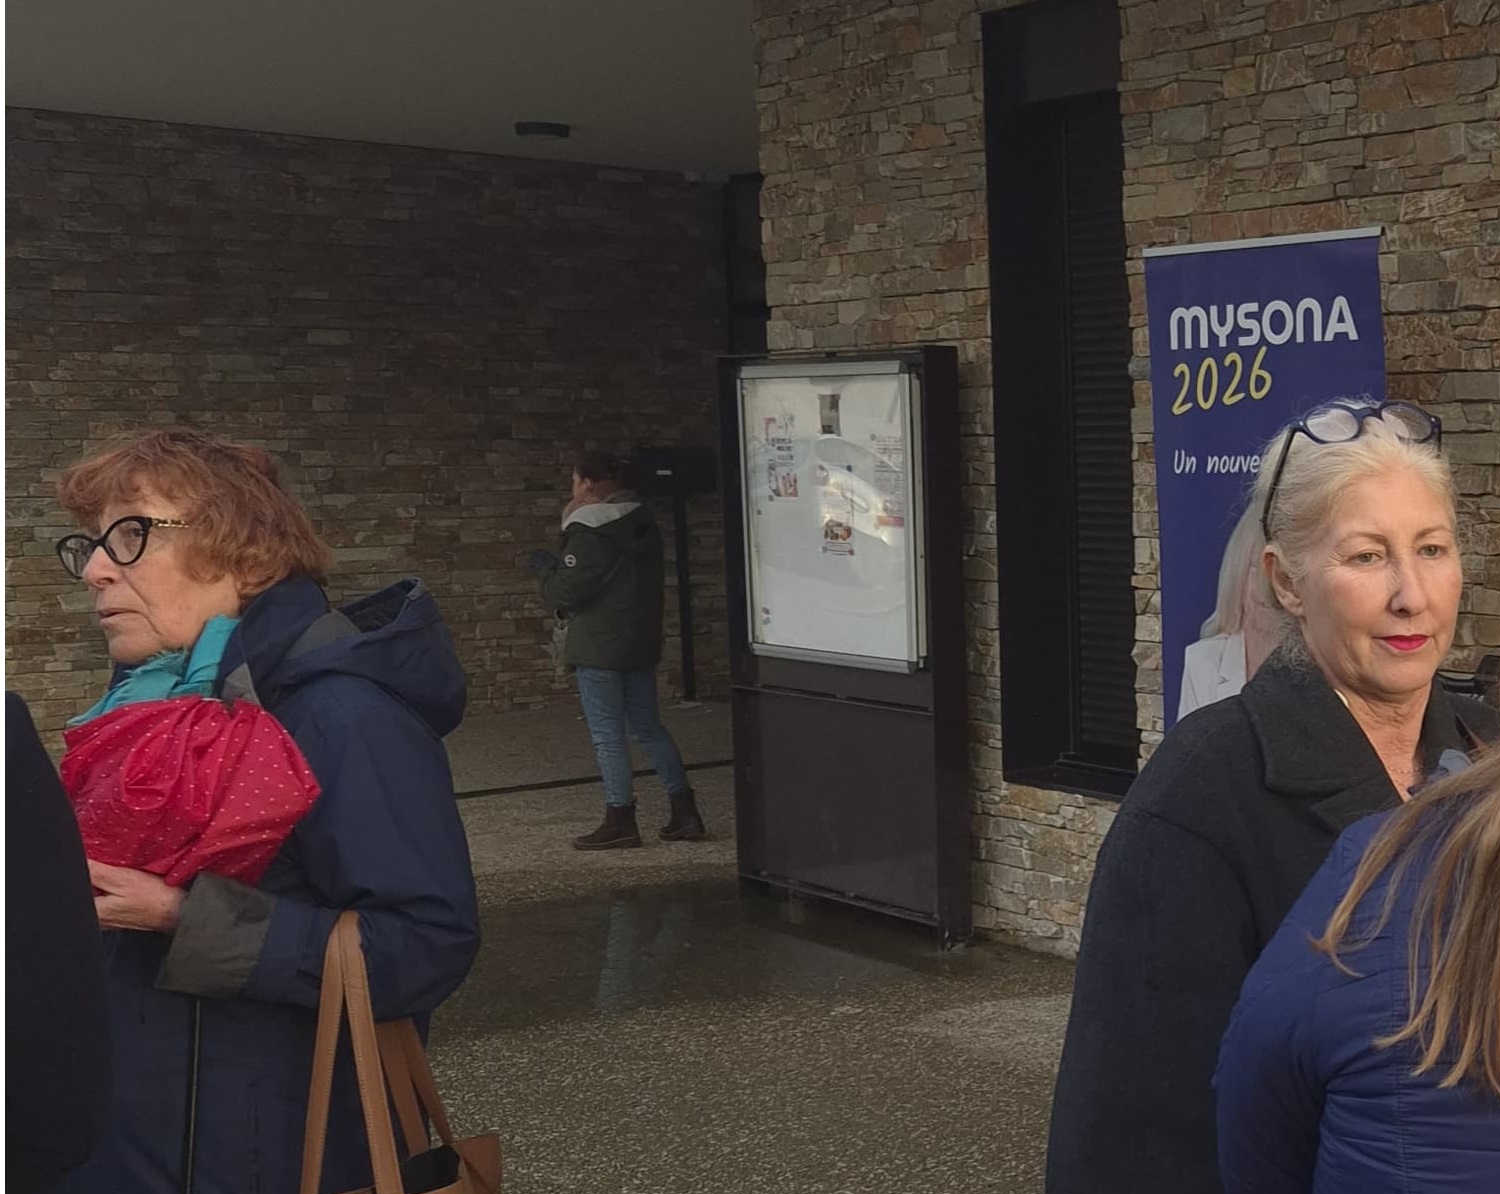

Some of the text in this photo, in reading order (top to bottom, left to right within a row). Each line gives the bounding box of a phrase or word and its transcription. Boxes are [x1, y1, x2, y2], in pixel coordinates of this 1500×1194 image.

[1170, 296, 1359, 350] MYSONA
[1171, 346, 1273, 416] 2026
[1174, 449, 1197, 474] Un
